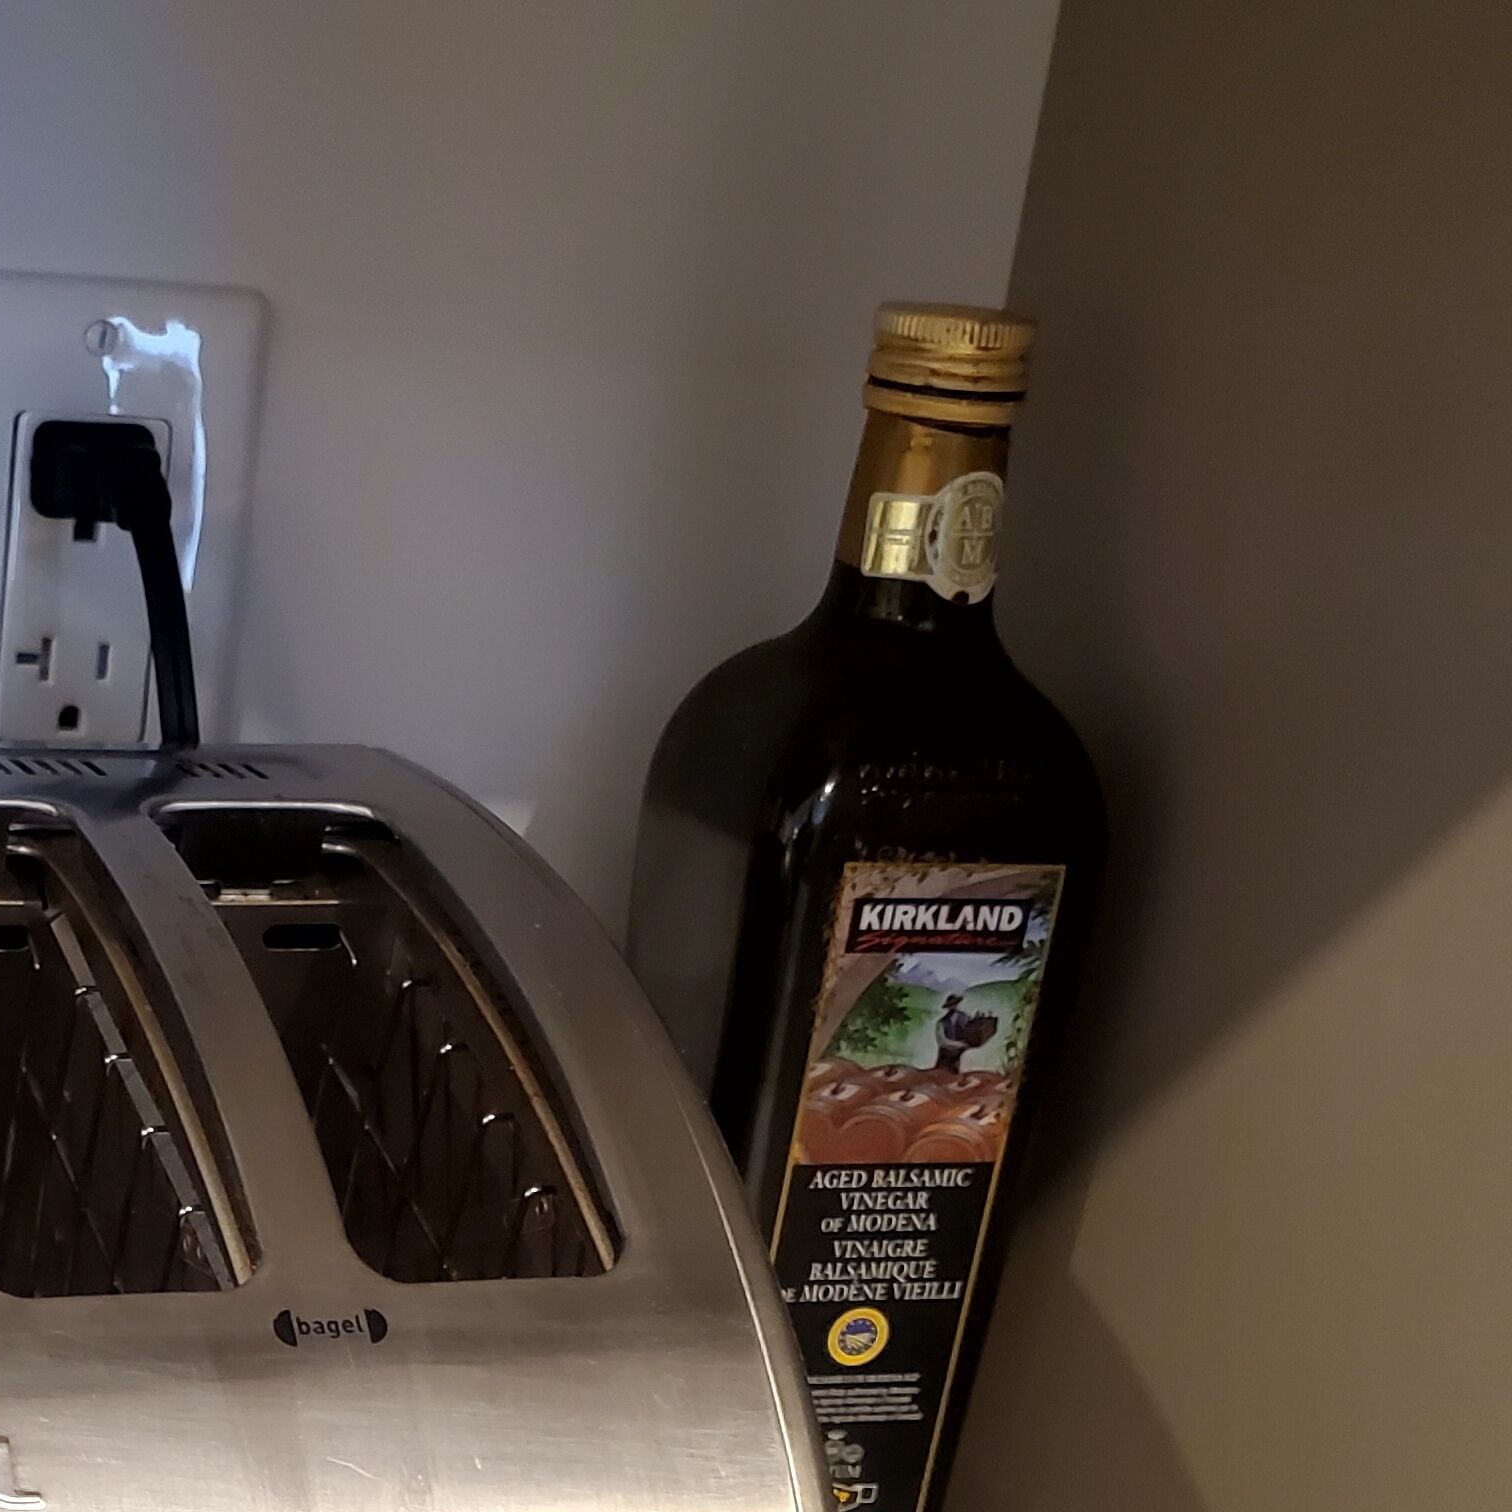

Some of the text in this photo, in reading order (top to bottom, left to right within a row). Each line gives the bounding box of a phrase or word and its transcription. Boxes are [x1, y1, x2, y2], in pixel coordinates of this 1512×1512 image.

[859, 904, 1023, 932] KIRKLAND
[808, 1168, 974, 1189] AGED BALSAMIC
[840, 1191, 930, 1211] VINEGAR
[821, 1213, 938, 1233] OF MODENA
[833, 1239, 929, 1259] VINAIGRE
[809, 1260, 937, 1283] BALSAMIQUE
[893, 1281, 964, 1300] VIEILLI
[296, 1314, 364, 1339] bagel
